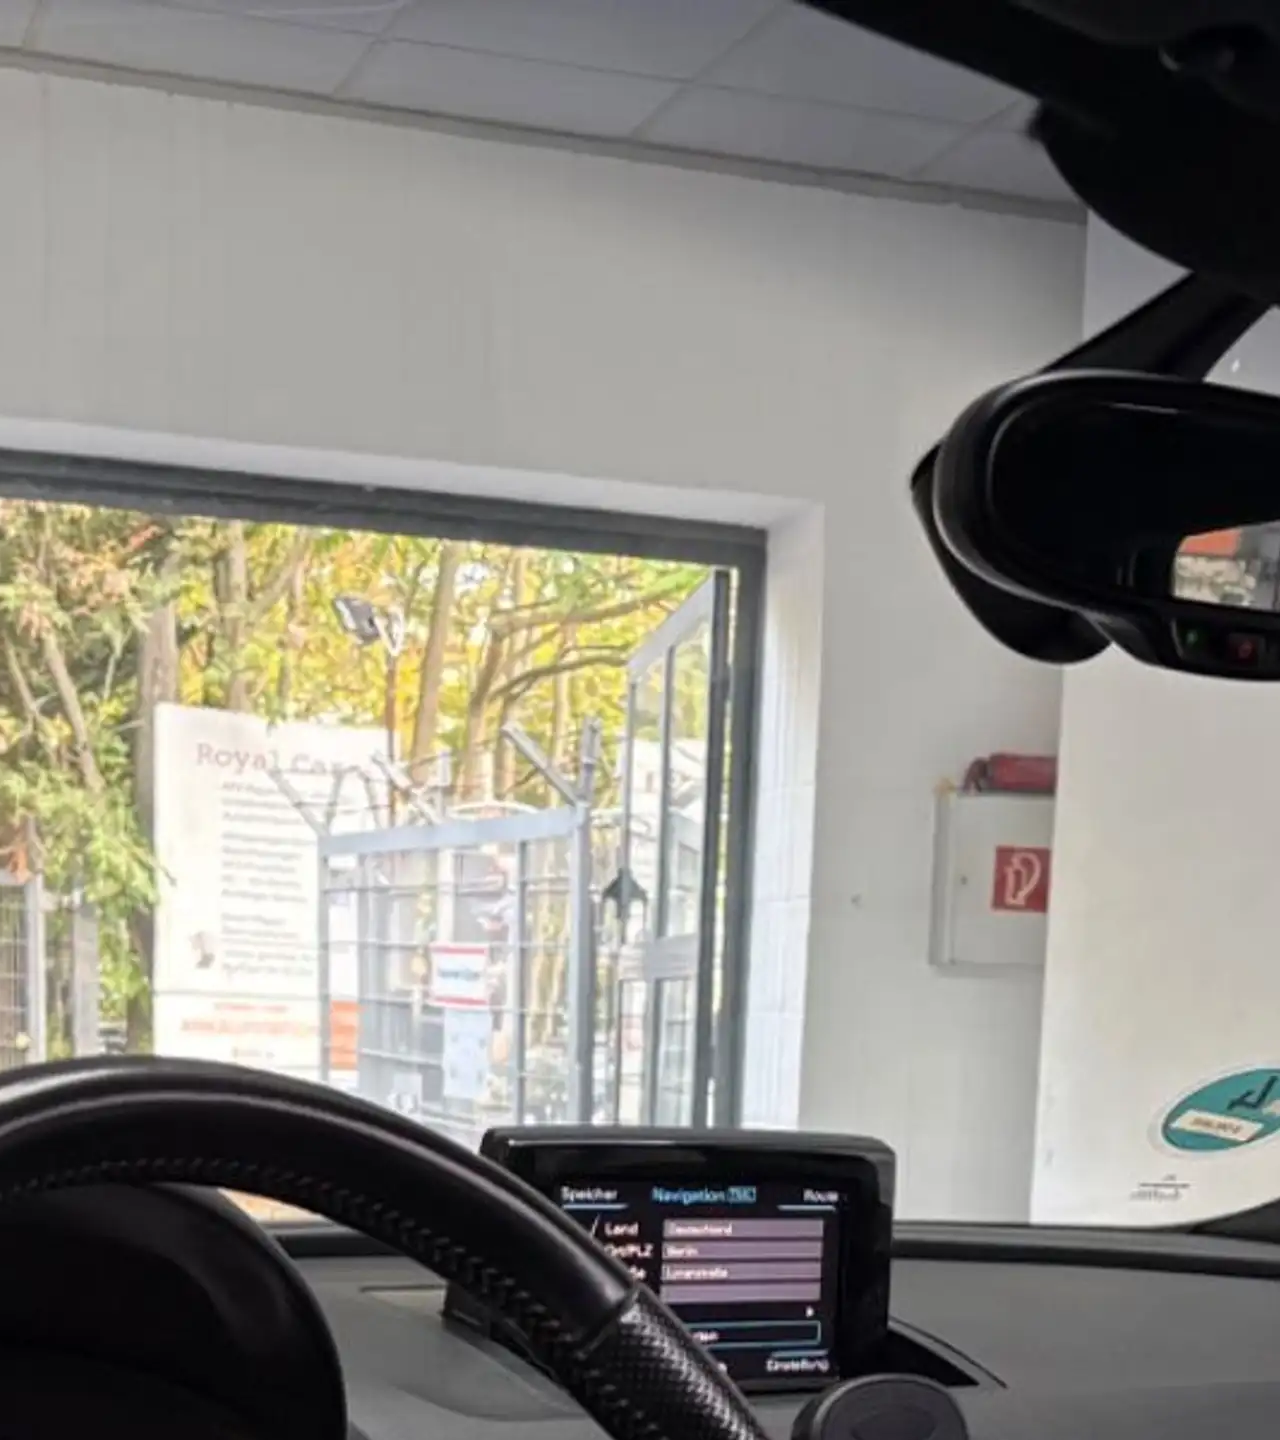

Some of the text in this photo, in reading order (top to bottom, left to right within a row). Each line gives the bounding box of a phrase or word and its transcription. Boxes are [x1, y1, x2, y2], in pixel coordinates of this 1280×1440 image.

[196, 743, 280, 774] Royal
[561, 1186, 619, 1202] Speicher
[652, 1185, 726, 1204] Navigation
[604, 1222, 639, 1236] Land
